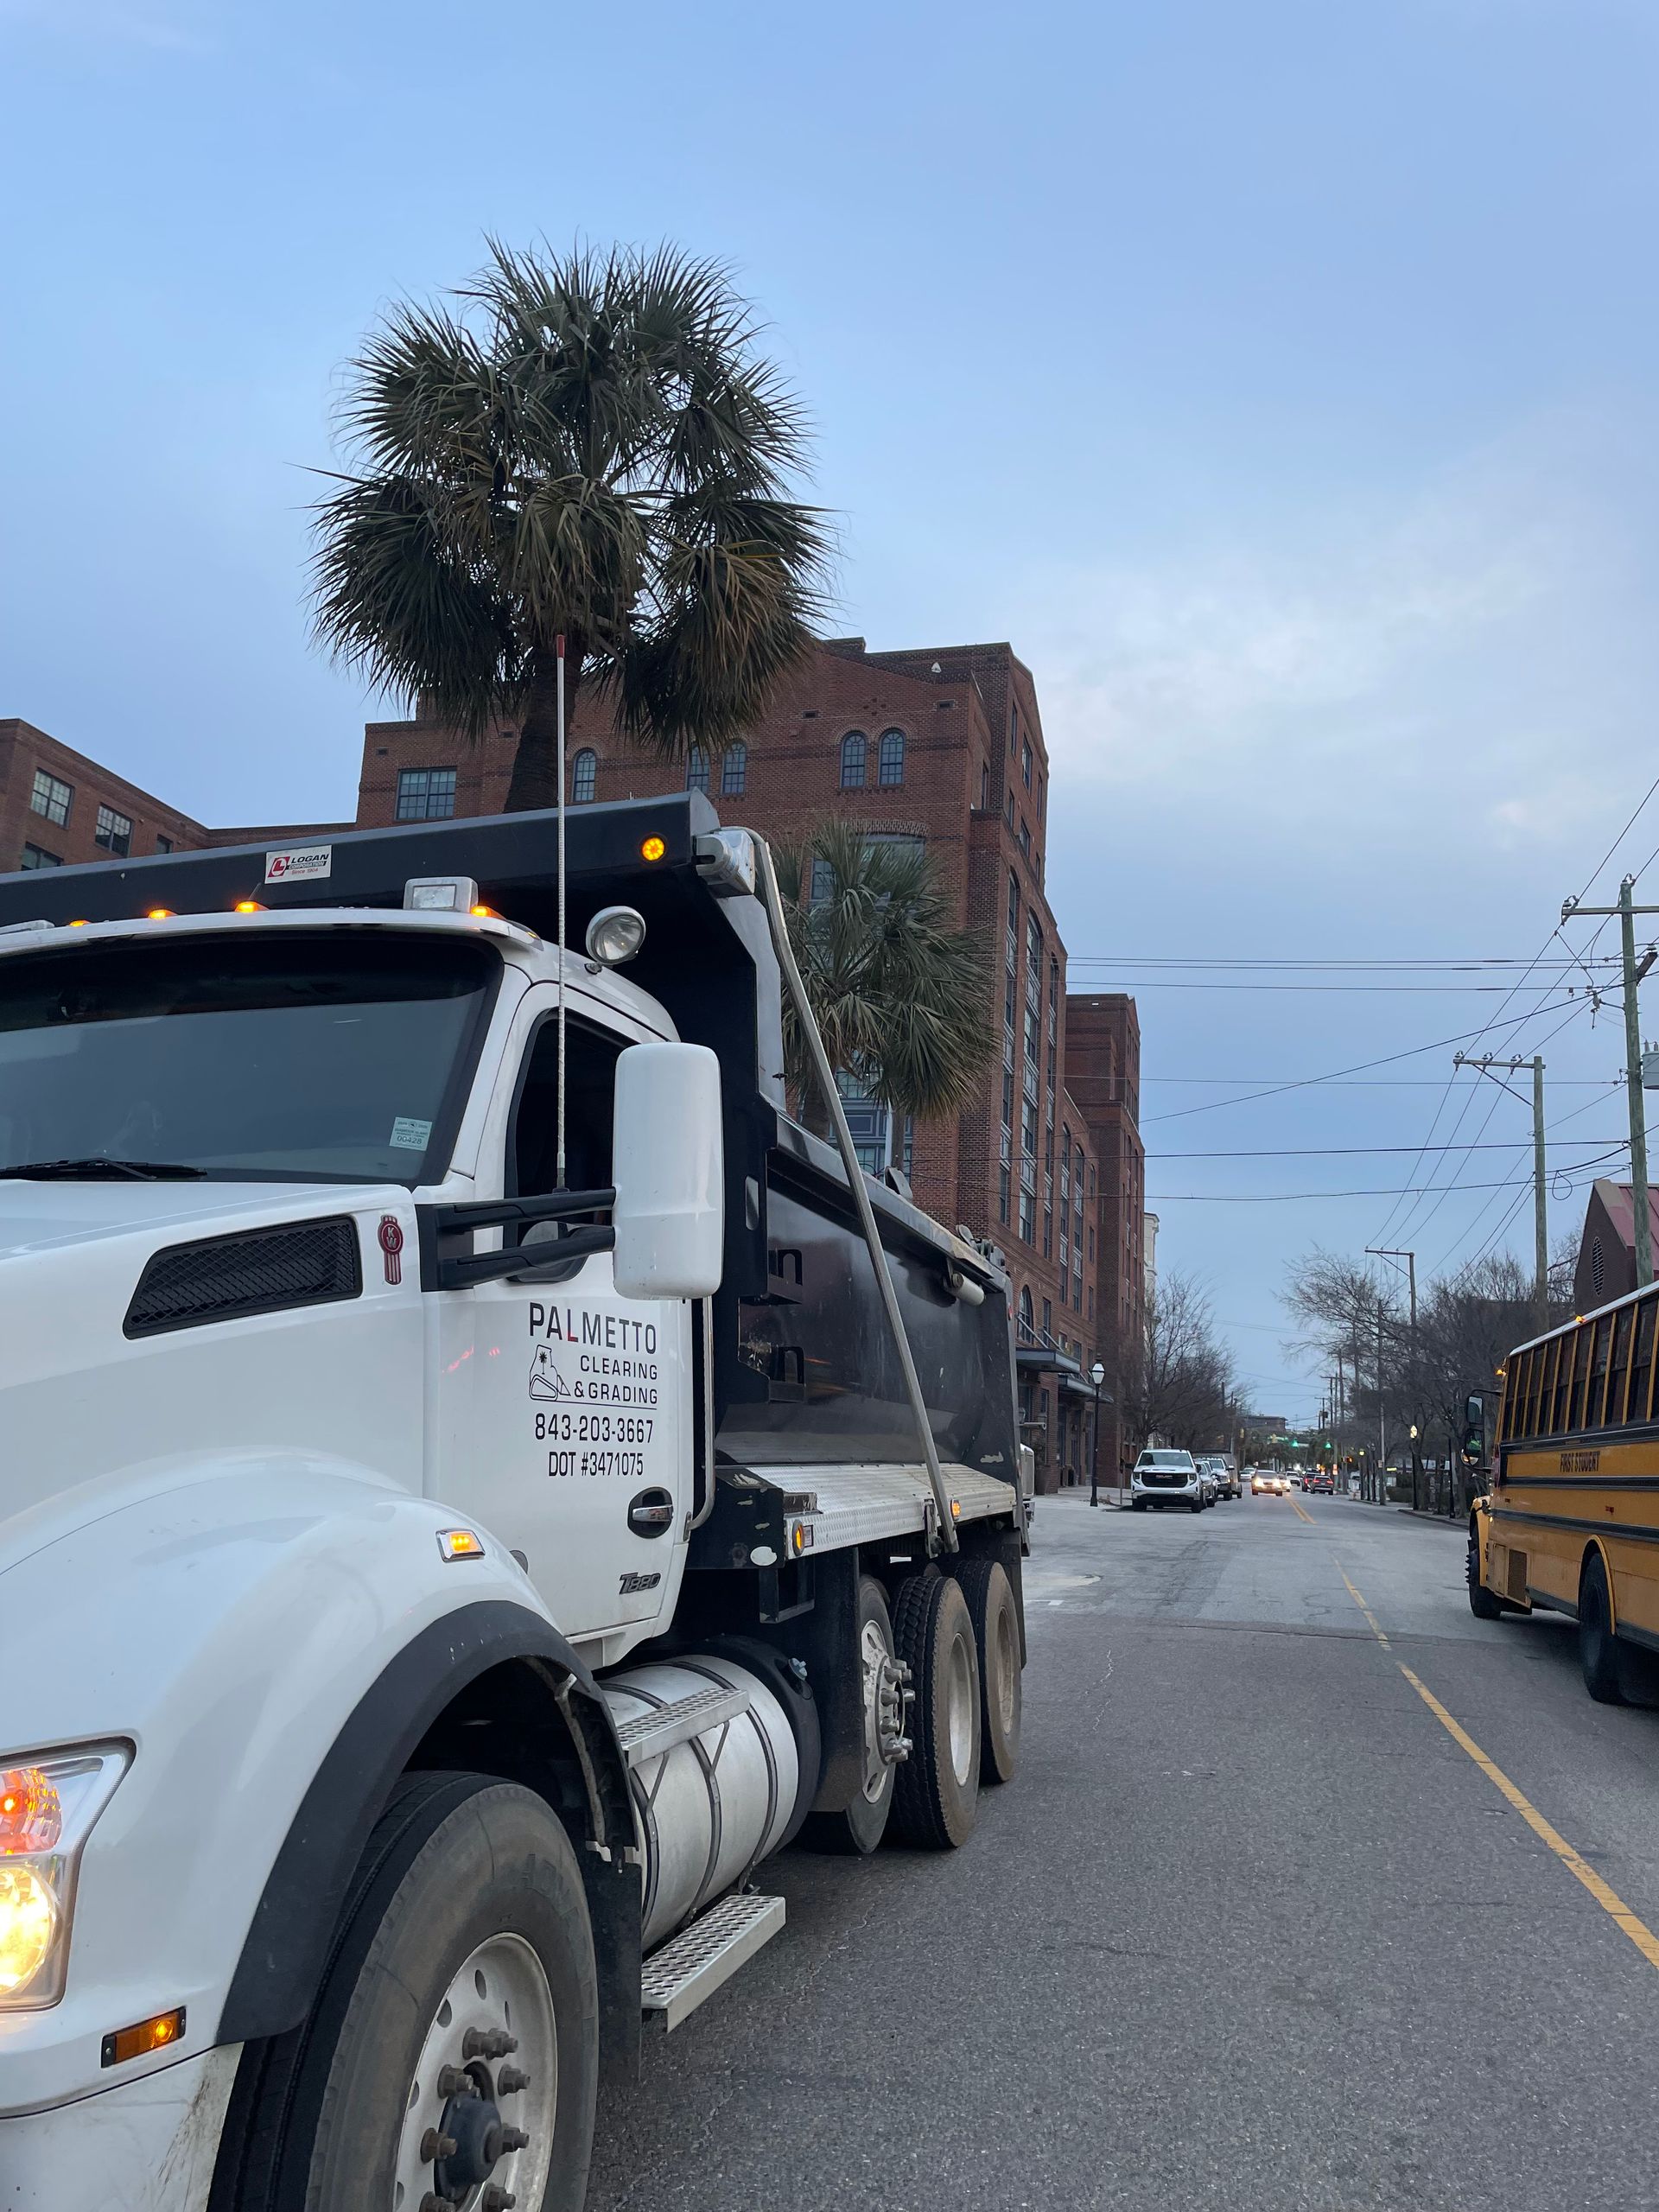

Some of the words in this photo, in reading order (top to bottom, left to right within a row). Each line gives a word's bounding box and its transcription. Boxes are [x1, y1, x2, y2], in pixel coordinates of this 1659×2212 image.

[291, 854, 329, 863] LOGAN
[397, 1135, 423, 1144] 00428
[529, 1302, 657, 1355] PALMETTO
[580, 1355, 658, 1380] CLEARING
[535, 1413, 654, 1444] 843-203-3667
[548, 1451, 577, 1477] DOT
[581, 1452, 644, 1477] #3471075
[619, 1572, 661, 1595] T880
